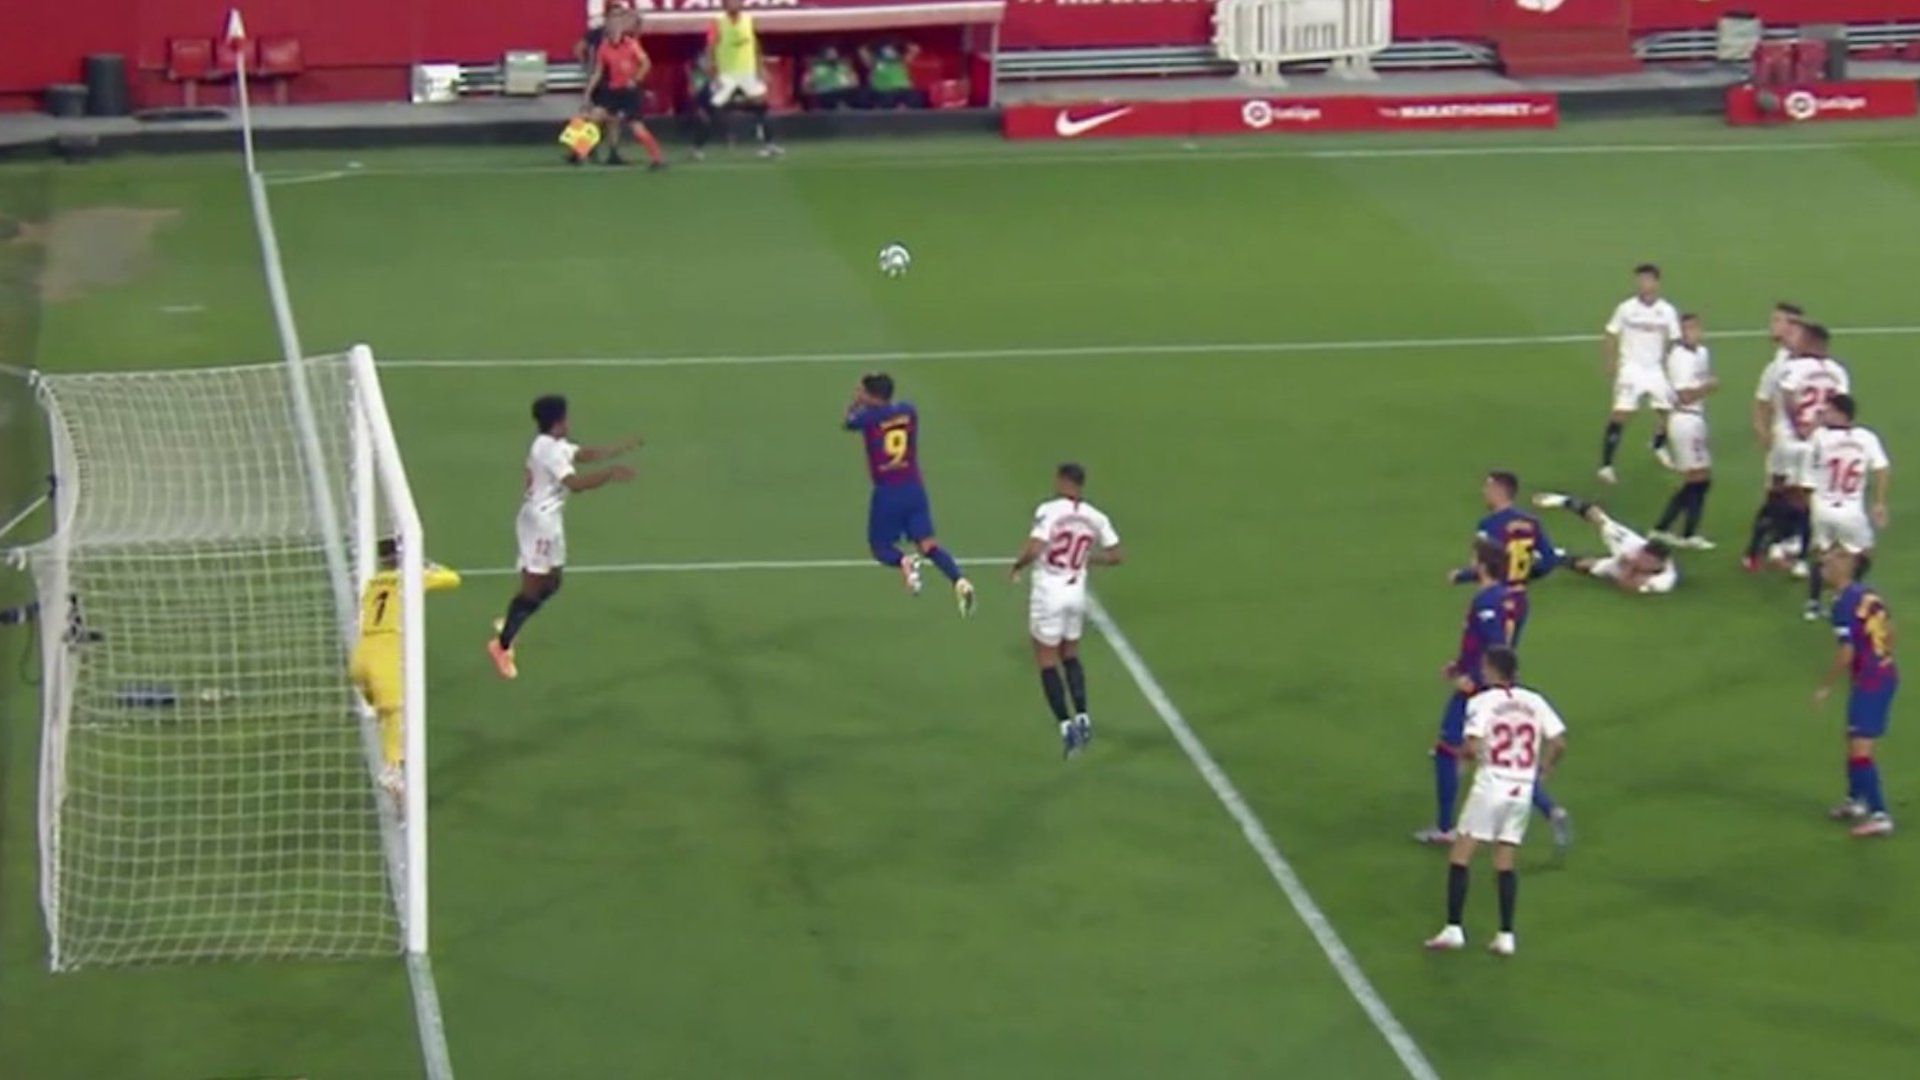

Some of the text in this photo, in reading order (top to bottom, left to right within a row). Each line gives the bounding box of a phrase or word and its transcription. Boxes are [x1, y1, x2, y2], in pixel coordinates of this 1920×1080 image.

[882, 429, 908, 468] 9
[1828, 458, 1863, 493] 16
[1047, 531, 1095, 571] 20
[373, 590, 389, 626] 1
[1491, 723, 1536, 769] 23
